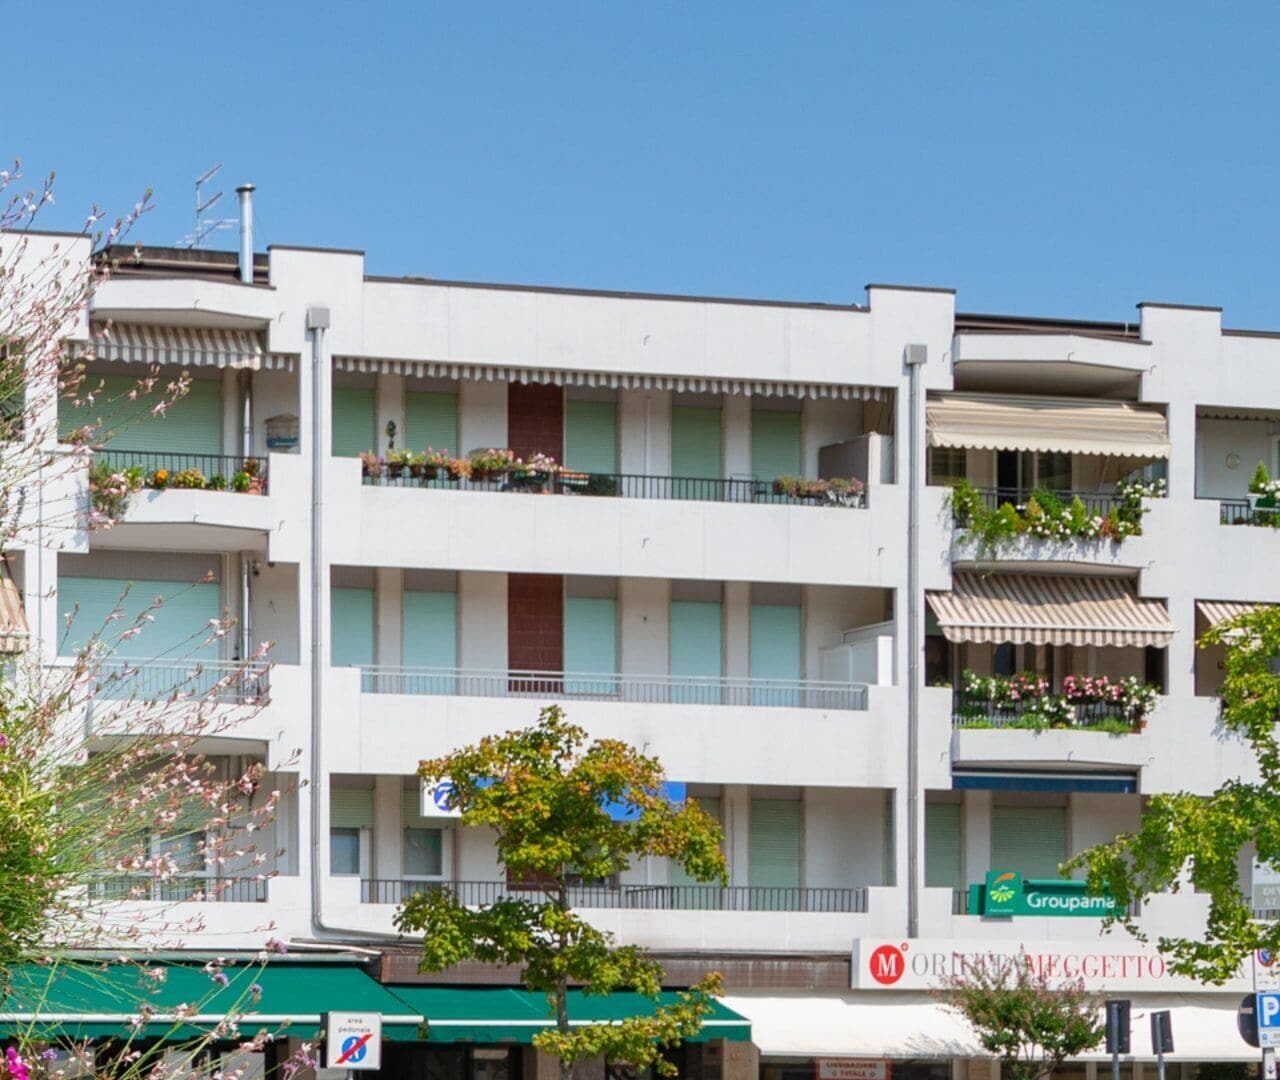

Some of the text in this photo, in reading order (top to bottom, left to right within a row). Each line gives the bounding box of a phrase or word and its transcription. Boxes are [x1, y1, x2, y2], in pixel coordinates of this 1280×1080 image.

[1027, 891, 1116, 911] Groupama
[1026, 954, 1166, 979] MEGGETTO
[1262, 996, 1280, 1026] P
